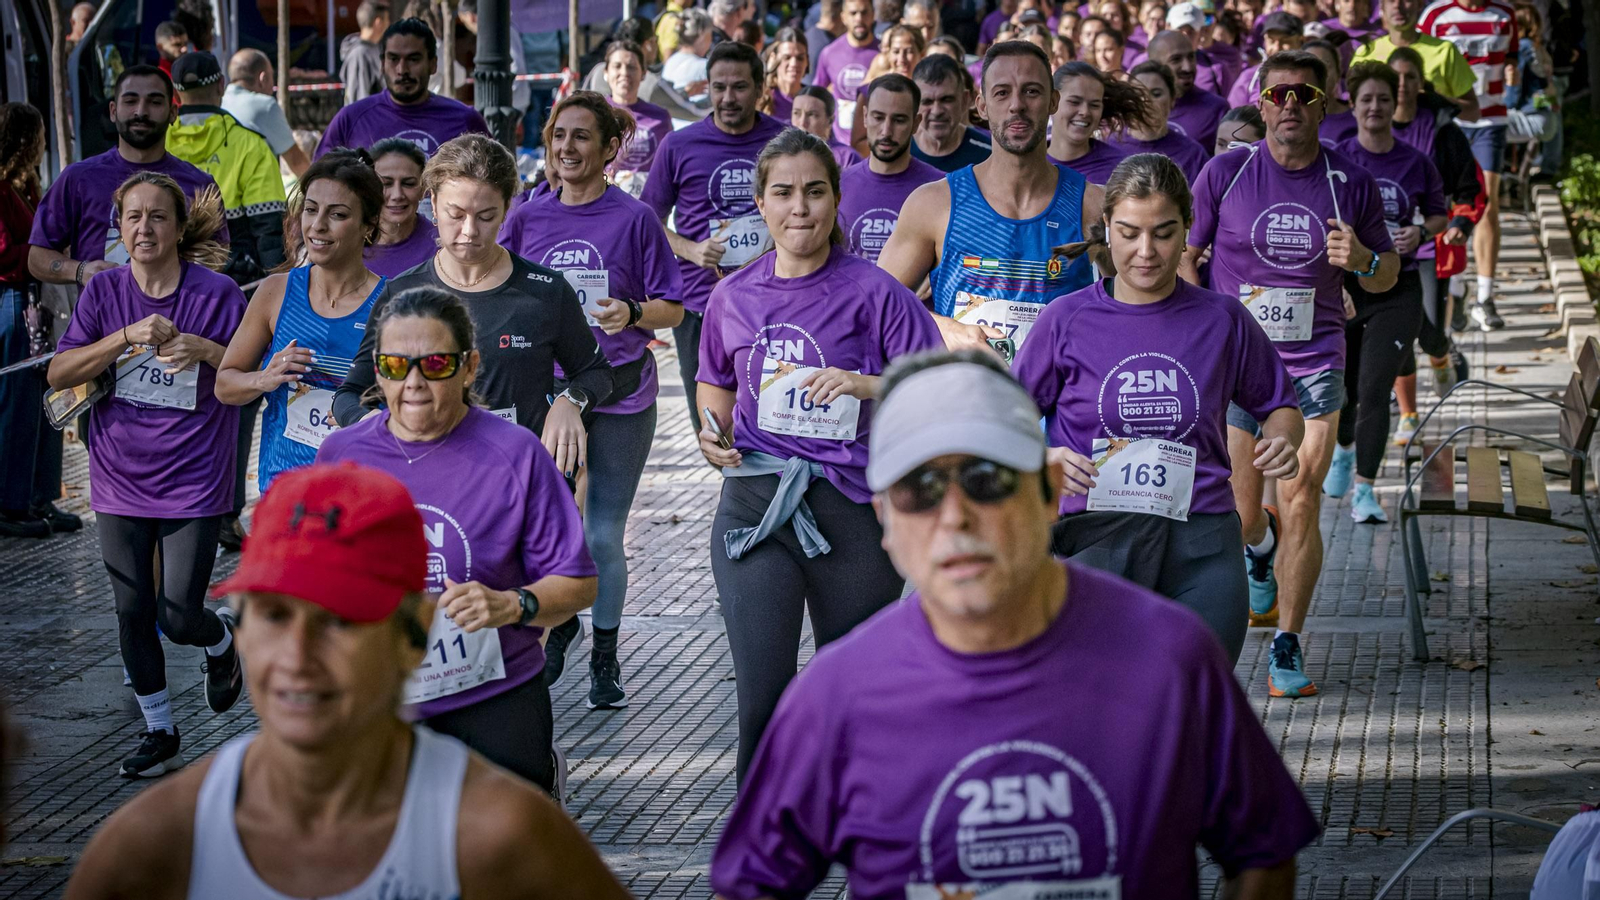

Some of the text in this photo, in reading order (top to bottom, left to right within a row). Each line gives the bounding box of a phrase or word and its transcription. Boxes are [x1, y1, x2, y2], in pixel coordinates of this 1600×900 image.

[721, 169, 756, 184] 25N
[862, 219, 899, 234] 25N
[1268, 213, 1310, 230] 25N
[730, 232, 759, 249] 649
[550, 249, 590, 265] 25N
[527, 273, 554, 283] 2XU
[1259, 305, 1294, 322] 384
[1119, 354, 1140, 366] CONTRA
[1148, 352, 1176, 364] VIOLENCIA
[1176, 362, 1189, 375] HACIA
[140, 366, 174, 387] 789
[1117, 370, 1178, 394] 25N
[310, 408, 333, 430] 64
[773, 412, 796, 420] ROMPE
[1123, 408, 1142, 416] 900
[1155, 406, 1164, 414] 21
[1158, 444, 1193, 457] CARRERA
[1121, 463, 1167, 487] 163
[1154, 493, 1174, 502] CERO
[444, 513, 460, 529] HACIA
[458, 528, 467, 540] LAS
[428, 564, 442, 574] 30
[420, 634, 467, 668] 11
[424, 673, 442, 682] UNA
[444, 664, 472, 677] MENOS
[955, 771, 1073, 826] 25N
